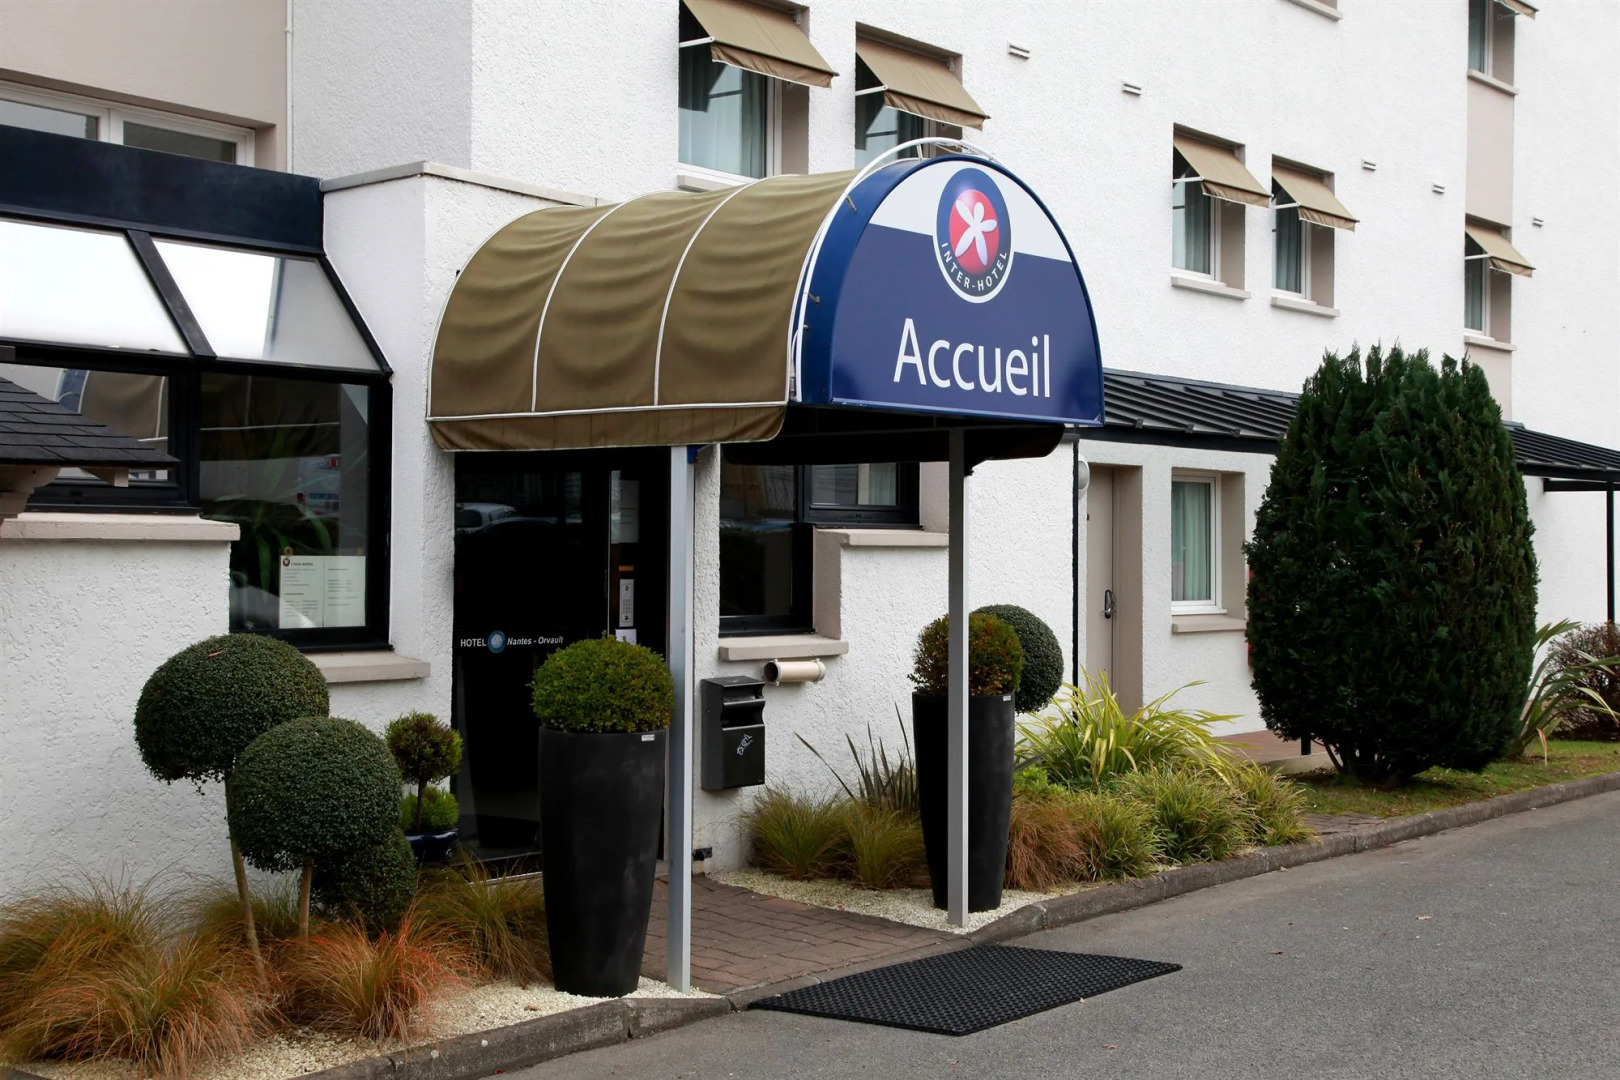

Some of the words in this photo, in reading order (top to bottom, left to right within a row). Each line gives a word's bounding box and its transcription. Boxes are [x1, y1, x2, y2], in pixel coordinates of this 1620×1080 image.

[941, 242, 1008, 292] INTER-HOTEL
[893, 317, 1050, 398] Accueil
[460, 638, 487, 647] HOTEL
[507, 637, 532, 646] Nantes
[538, 635, 564, 645] Orvault
